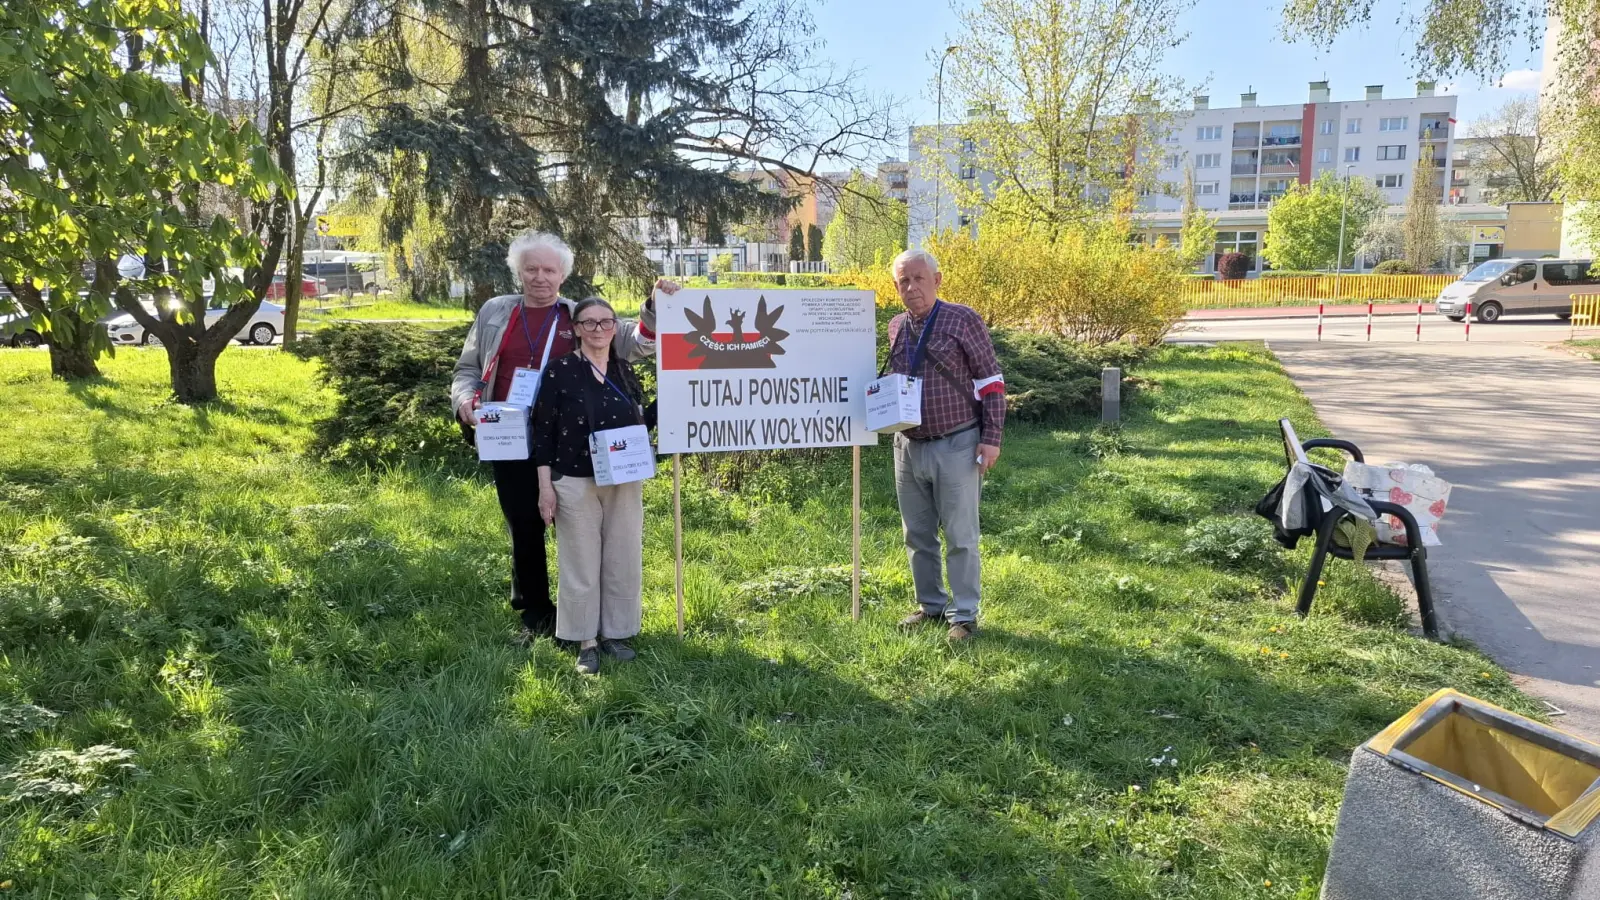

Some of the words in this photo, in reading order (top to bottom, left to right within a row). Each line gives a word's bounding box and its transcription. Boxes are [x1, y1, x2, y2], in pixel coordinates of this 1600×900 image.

[699, 335, 725, 351] CZEŚĆ
[726, 343, 740, 351] ICH
[740, 335, 771, 351] PAMIĘCI
[689, 380, 743, 407] TUTAJ
[749, 377, 848, 405] POWSTANIE
[688, 419, 756, 448] POMNIK
[761, 410, 851, 444] WOŁYŃSKI
